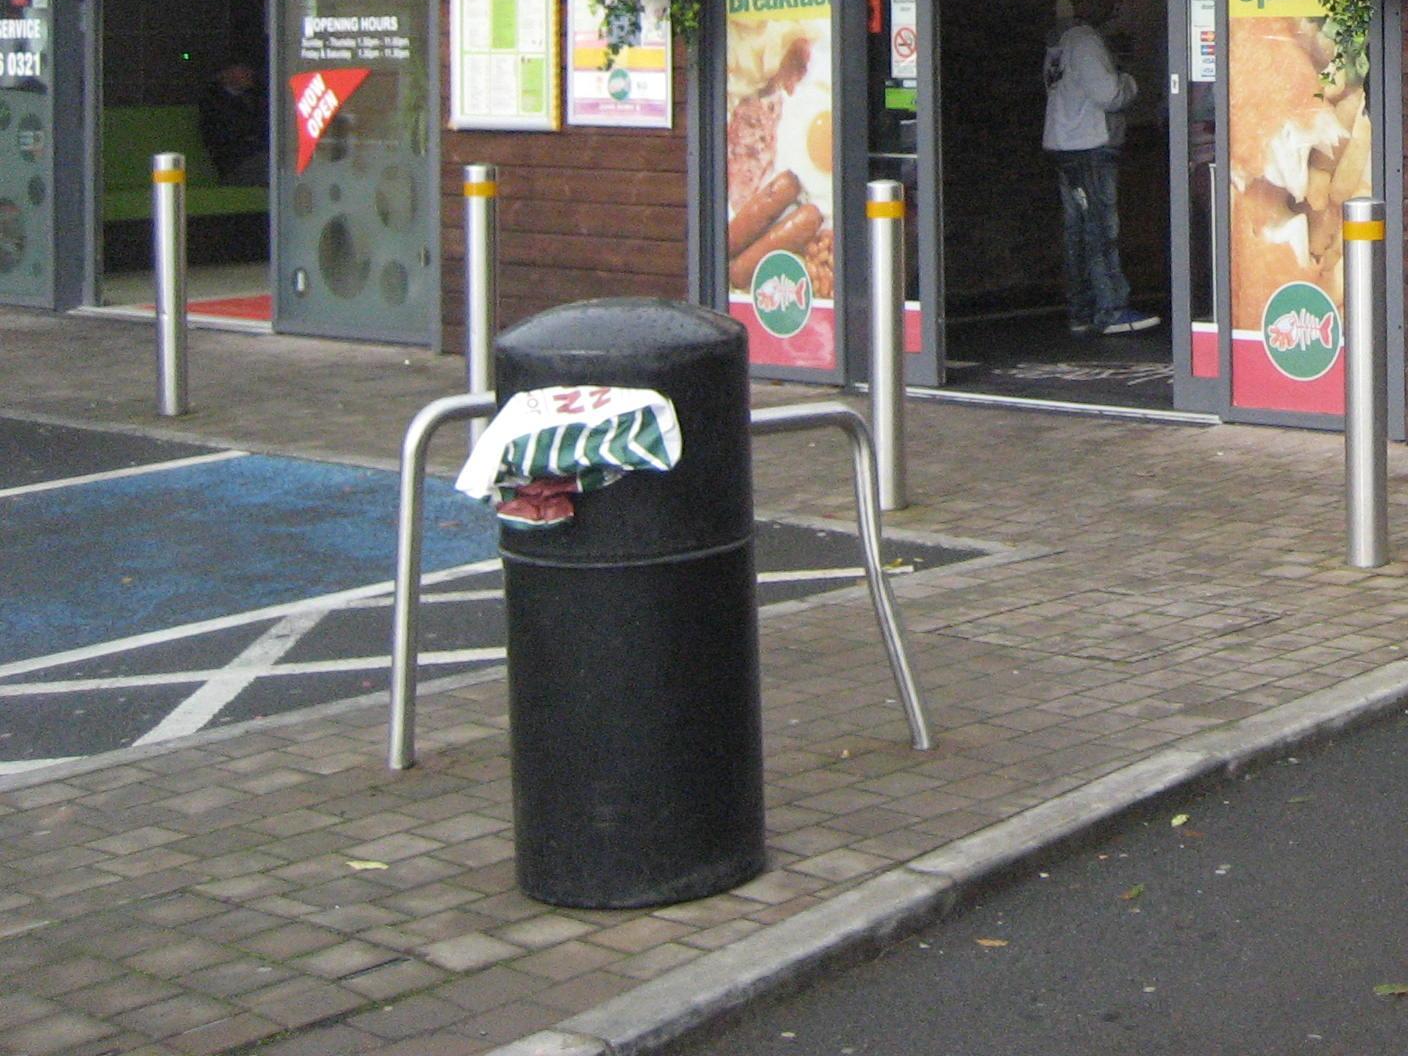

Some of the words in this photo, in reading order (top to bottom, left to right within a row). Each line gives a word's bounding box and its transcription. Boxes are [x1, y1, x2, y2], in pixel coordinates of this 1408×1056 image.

[313, 16, 359, 32] OPENING
[361, 16, 398, 31] HOURS
[8, 52, 41, 77] 0321
[298, 72, 326, 119] NOW
[307, 89, 339, 139] OPEN
